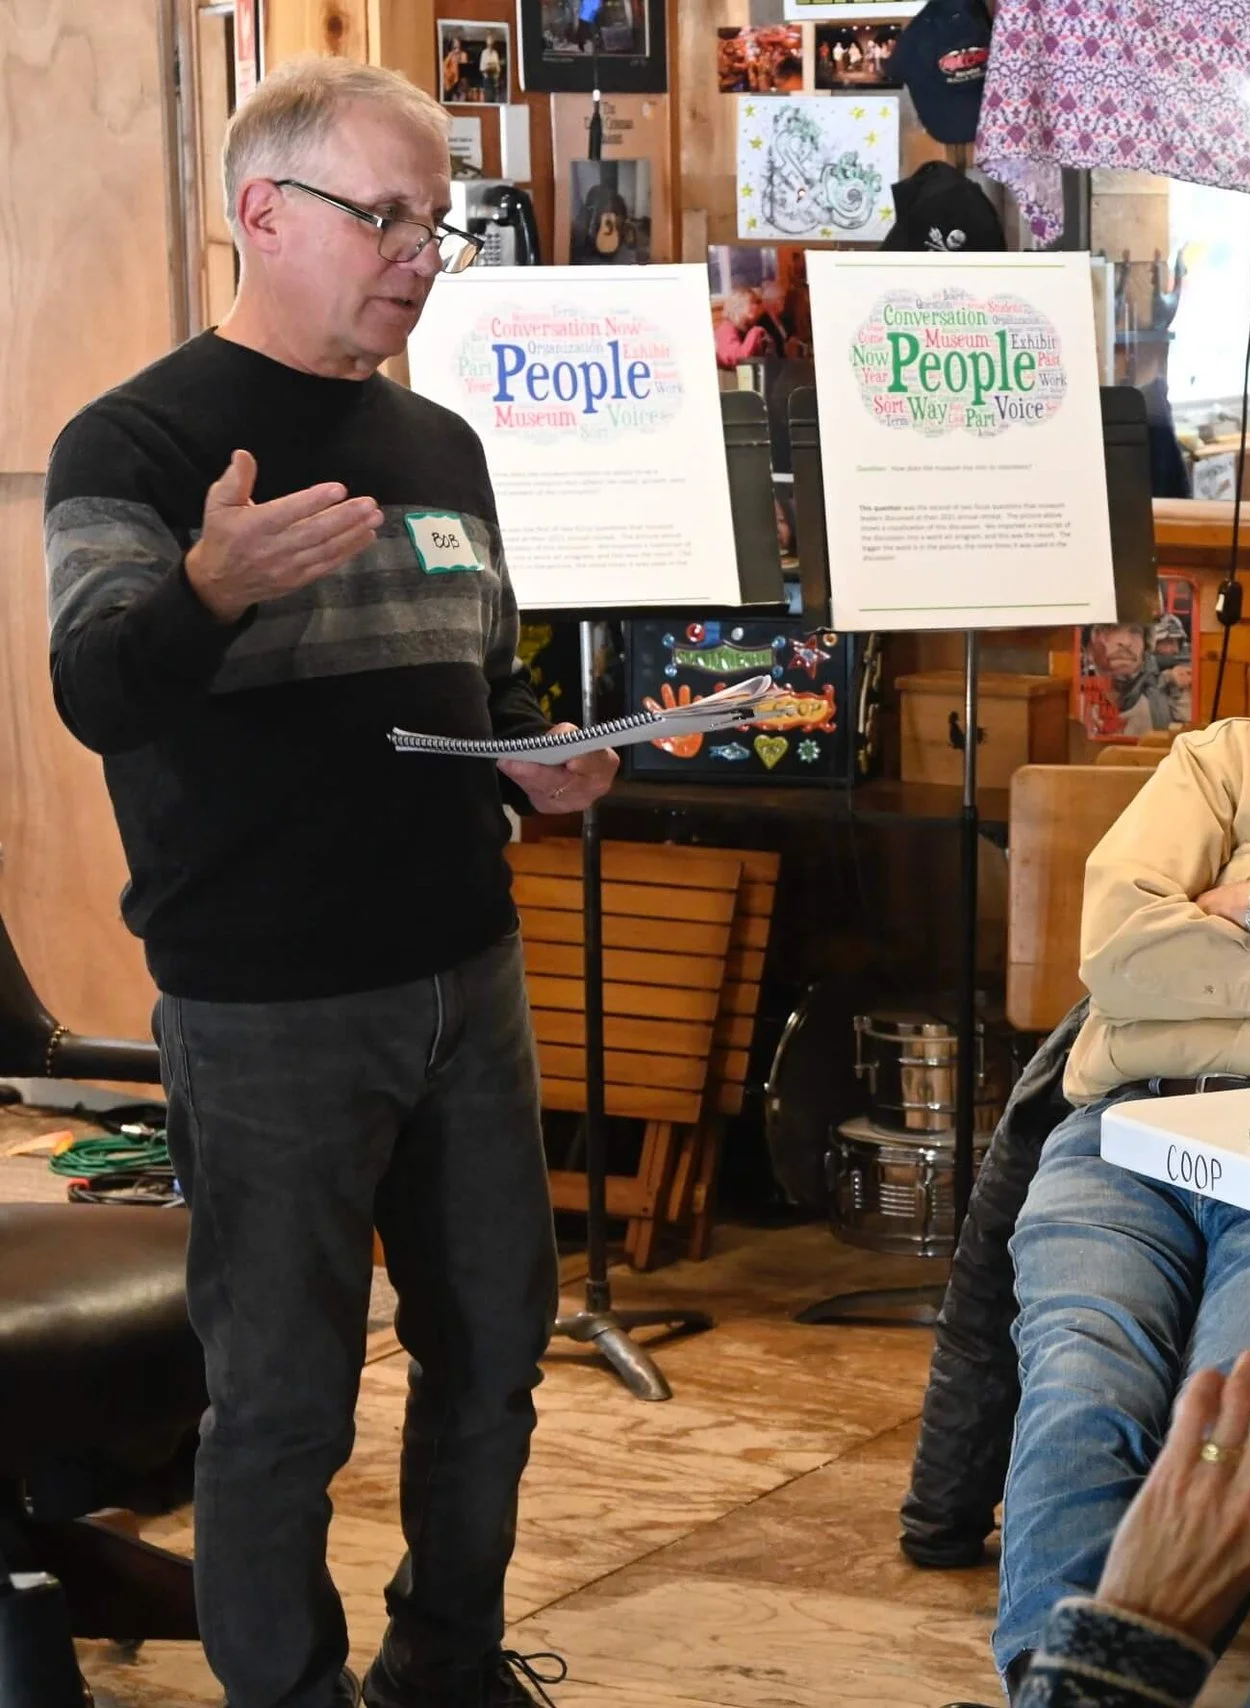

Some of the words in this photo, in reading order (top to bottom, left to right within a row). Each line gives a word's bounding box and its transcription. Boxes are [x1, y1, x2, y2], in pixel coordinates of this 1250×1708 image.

[883, 304, 986, 326] Conversation
[491, 317, 601, 338] Conversation
[605, 317, 642, 336] Now
[925, 328, 989, 348] Museum
[528, 341, 604, 355] Organization
[1011, 333, 1056, 350] Exhibit
[852, 345, 889, 367] Now
[492, 340, 650, 414] People
[862, 368, 888, 383] Year
[887, 330, 1036, 406] People
[1039, 373, 1067, 387] Work
[874, 395, 905, 414] Sort
[907, 396, 947, 424] Way
[994, 395, 1044, 420] Voice
[494, 405, 577, 428] Museum
[607, 405, 660, 427] Voice
[966, 408, 996, 428] Part
[432, 532, 460, 550] BOB
[1167, 1144, 1222, 1191] COOP
